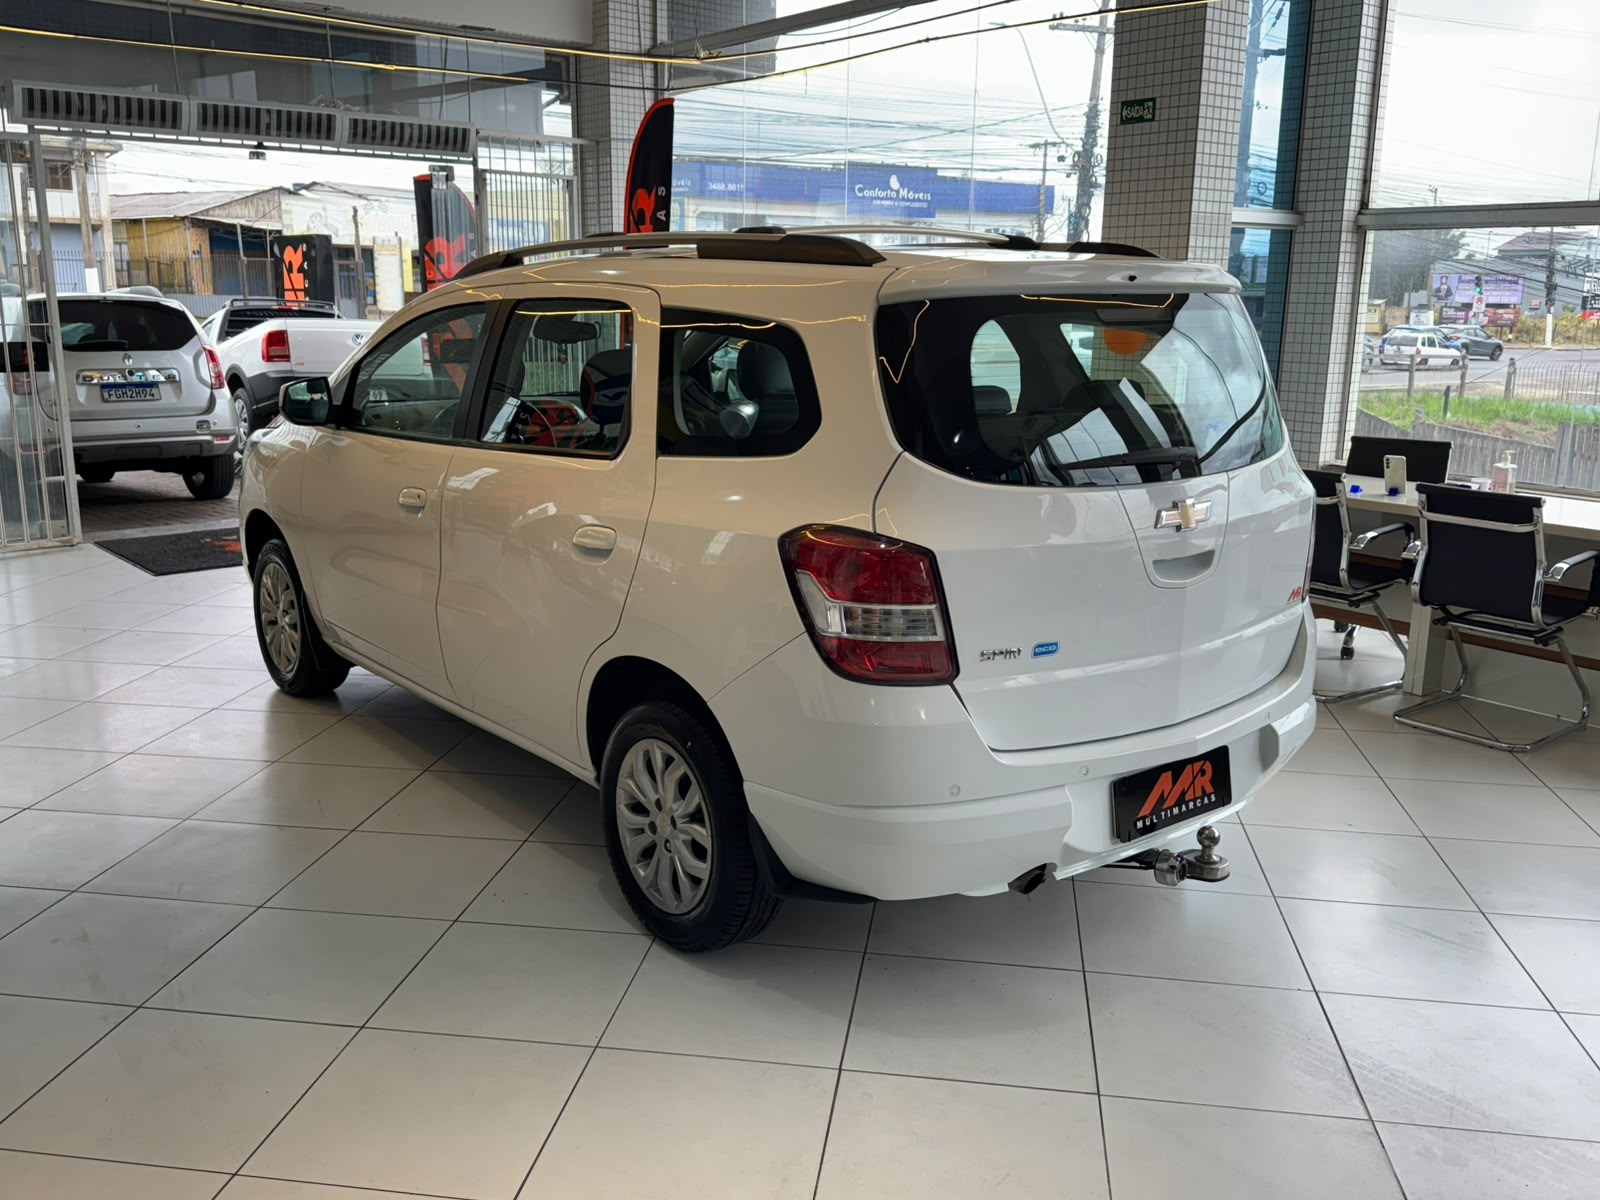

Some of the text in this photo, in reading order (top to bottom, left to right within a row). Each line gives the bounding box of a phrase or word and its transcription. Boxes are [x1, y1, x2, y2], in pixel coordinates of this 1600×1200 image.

[854, 184, 931, 201] Conforto Móveis
[1136, 794, 1216, 829] MULTIMARCAS
